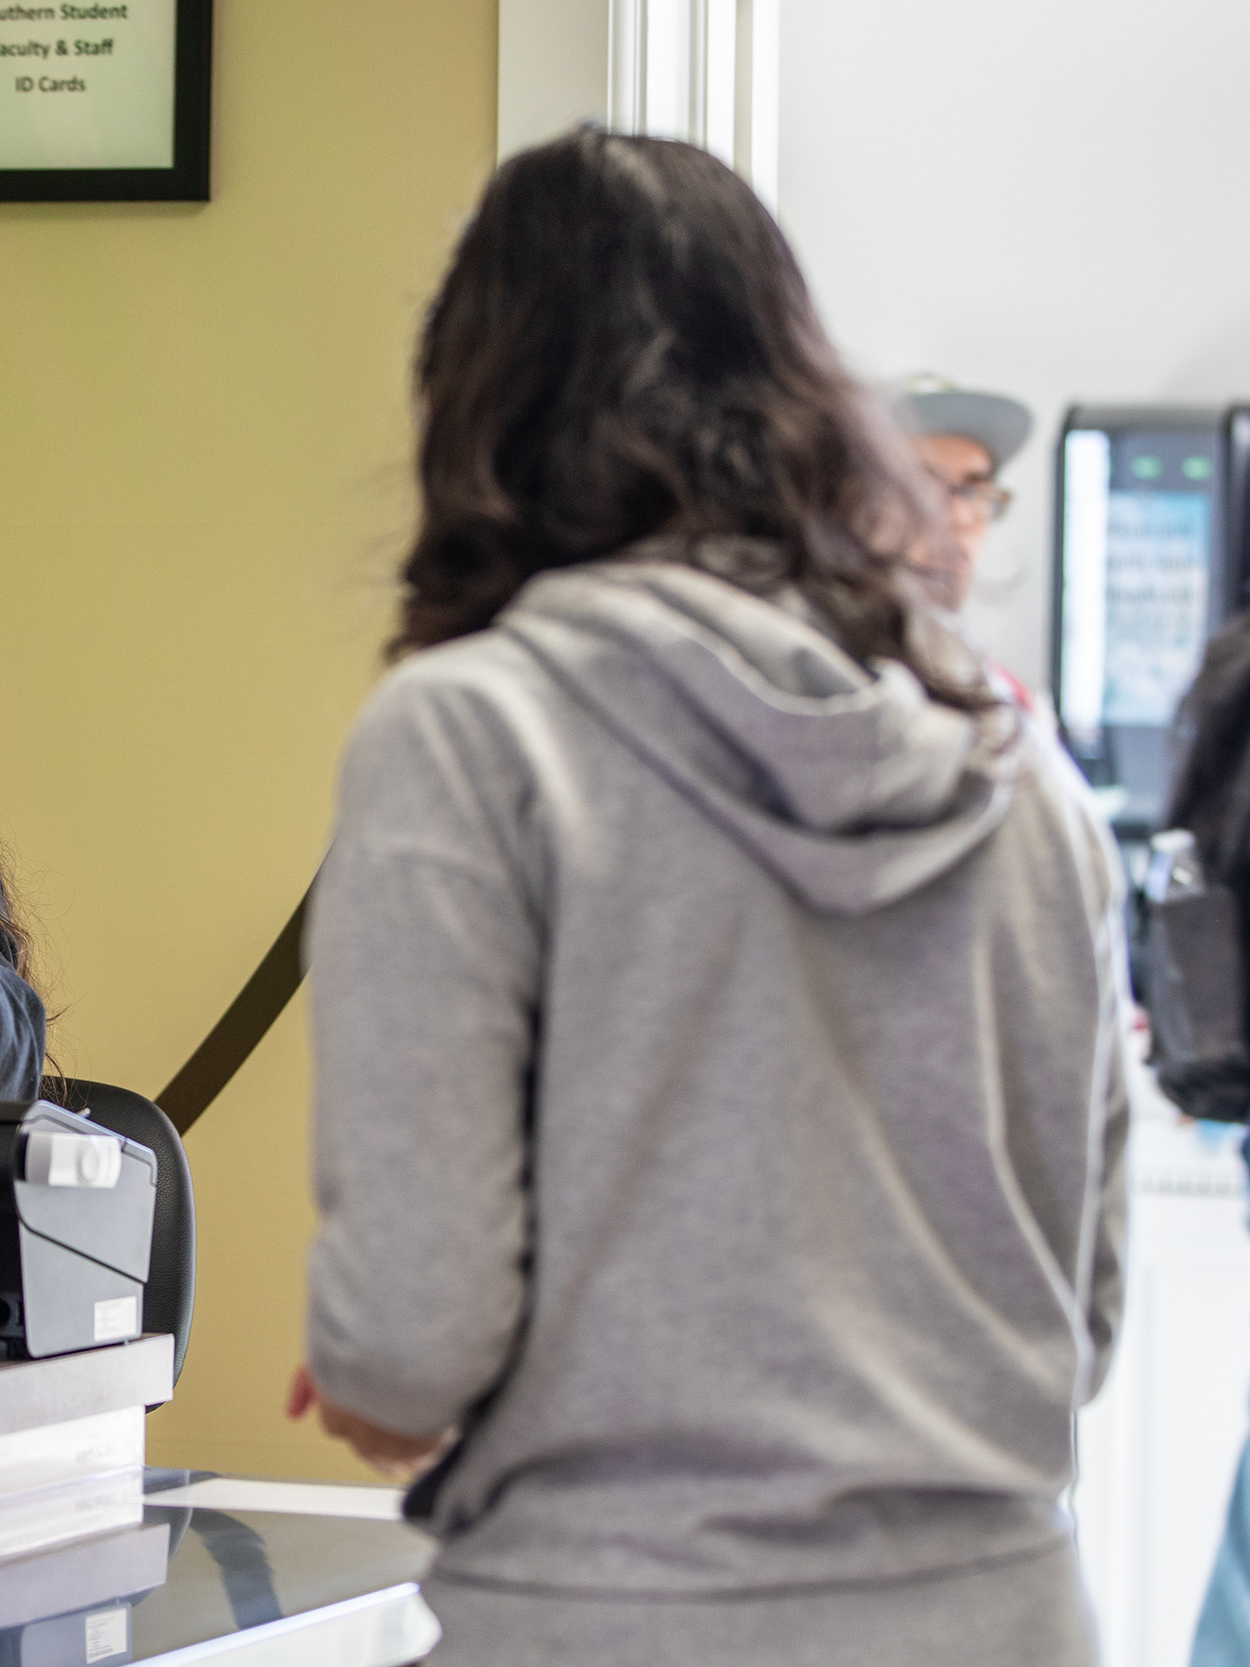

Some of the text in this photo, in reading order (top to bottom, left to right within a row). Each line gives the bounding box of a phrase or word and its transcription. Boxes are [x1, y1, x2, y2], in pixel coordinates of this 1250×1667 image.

[60, 3, 128, 20] Student
[55, 39, 68, 56] &
[74, 38, 114, 56] Staff
[15, 74, 86, 92] ID Cards
